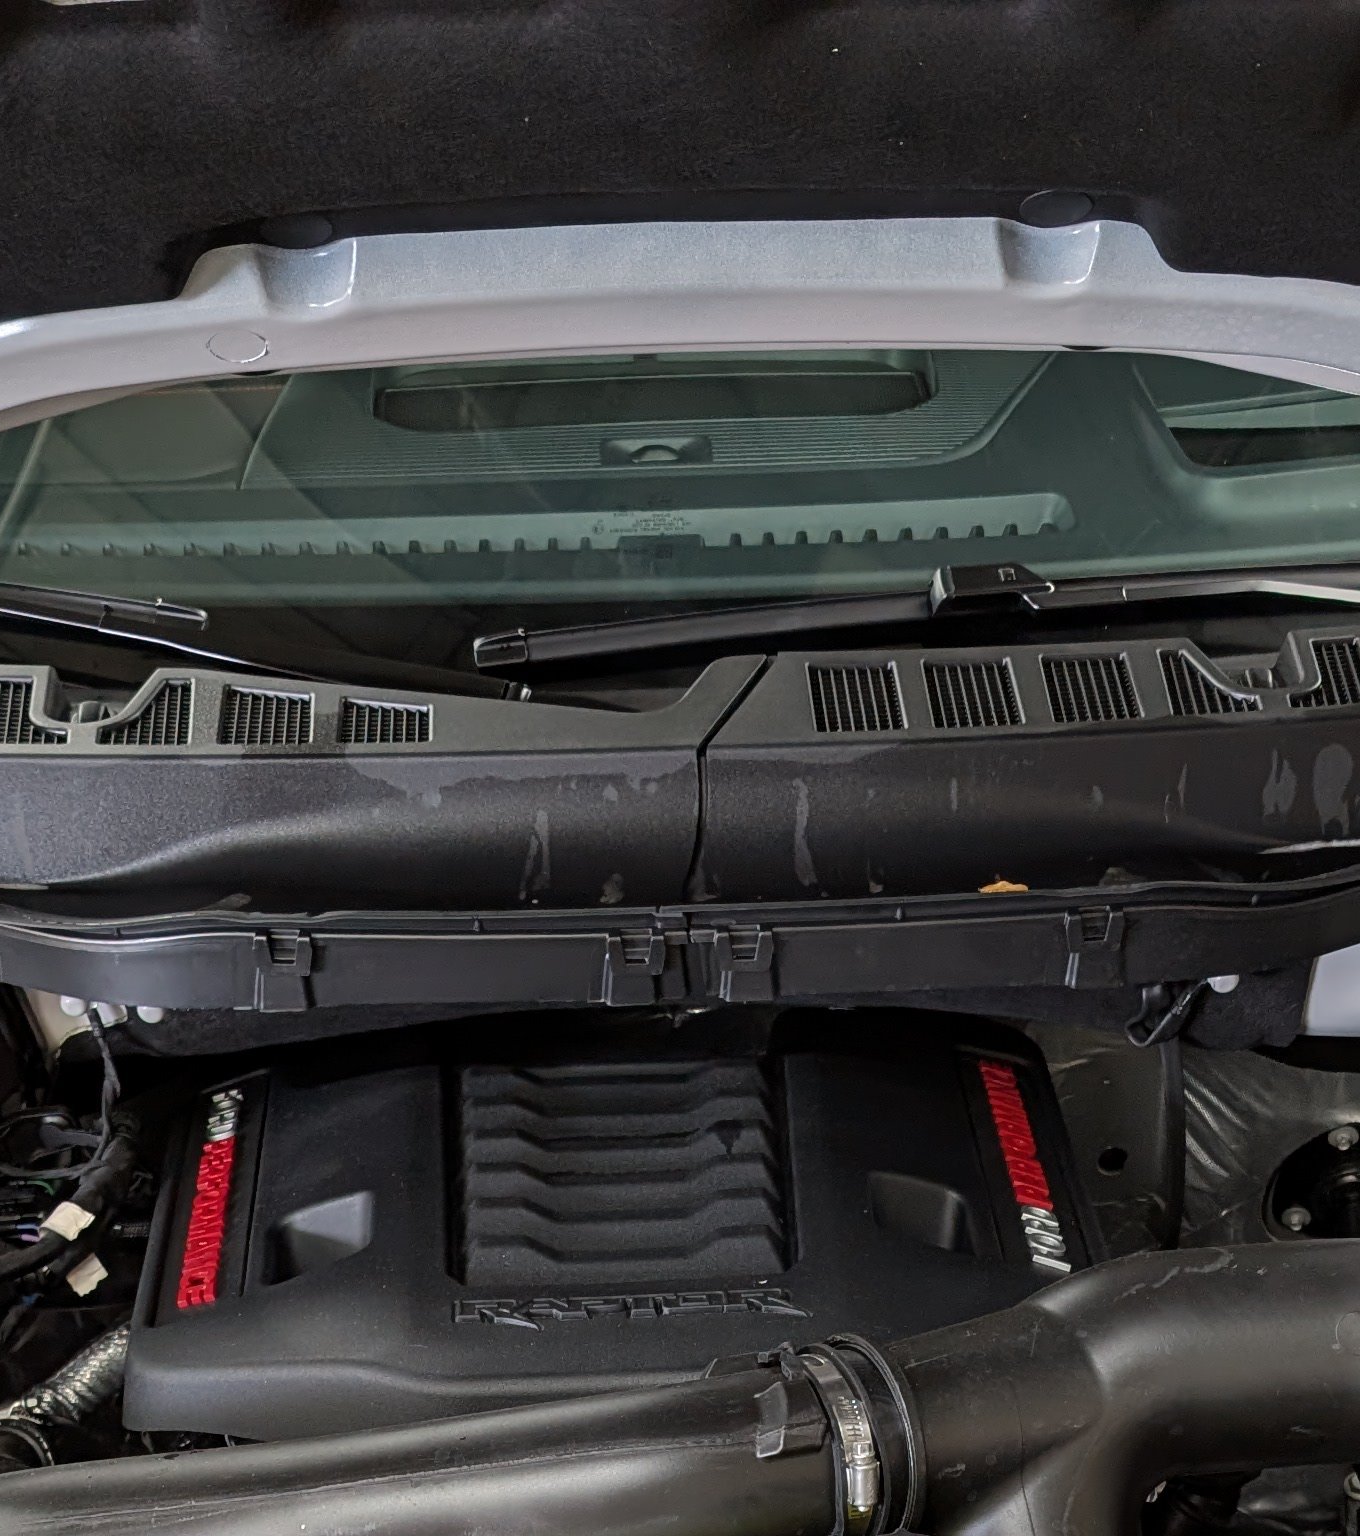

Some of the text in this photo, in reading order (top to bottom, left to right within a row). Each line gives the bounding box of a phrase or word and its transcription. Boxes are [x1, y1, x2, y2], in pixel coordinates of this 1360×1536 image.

[177, 1089, 244, 1308] FORD PERFORMANCE
[979, 1059, 1071, 1272] FORD PERFORMANCE
[452, 1289, 813, 1332] RAPTOR
